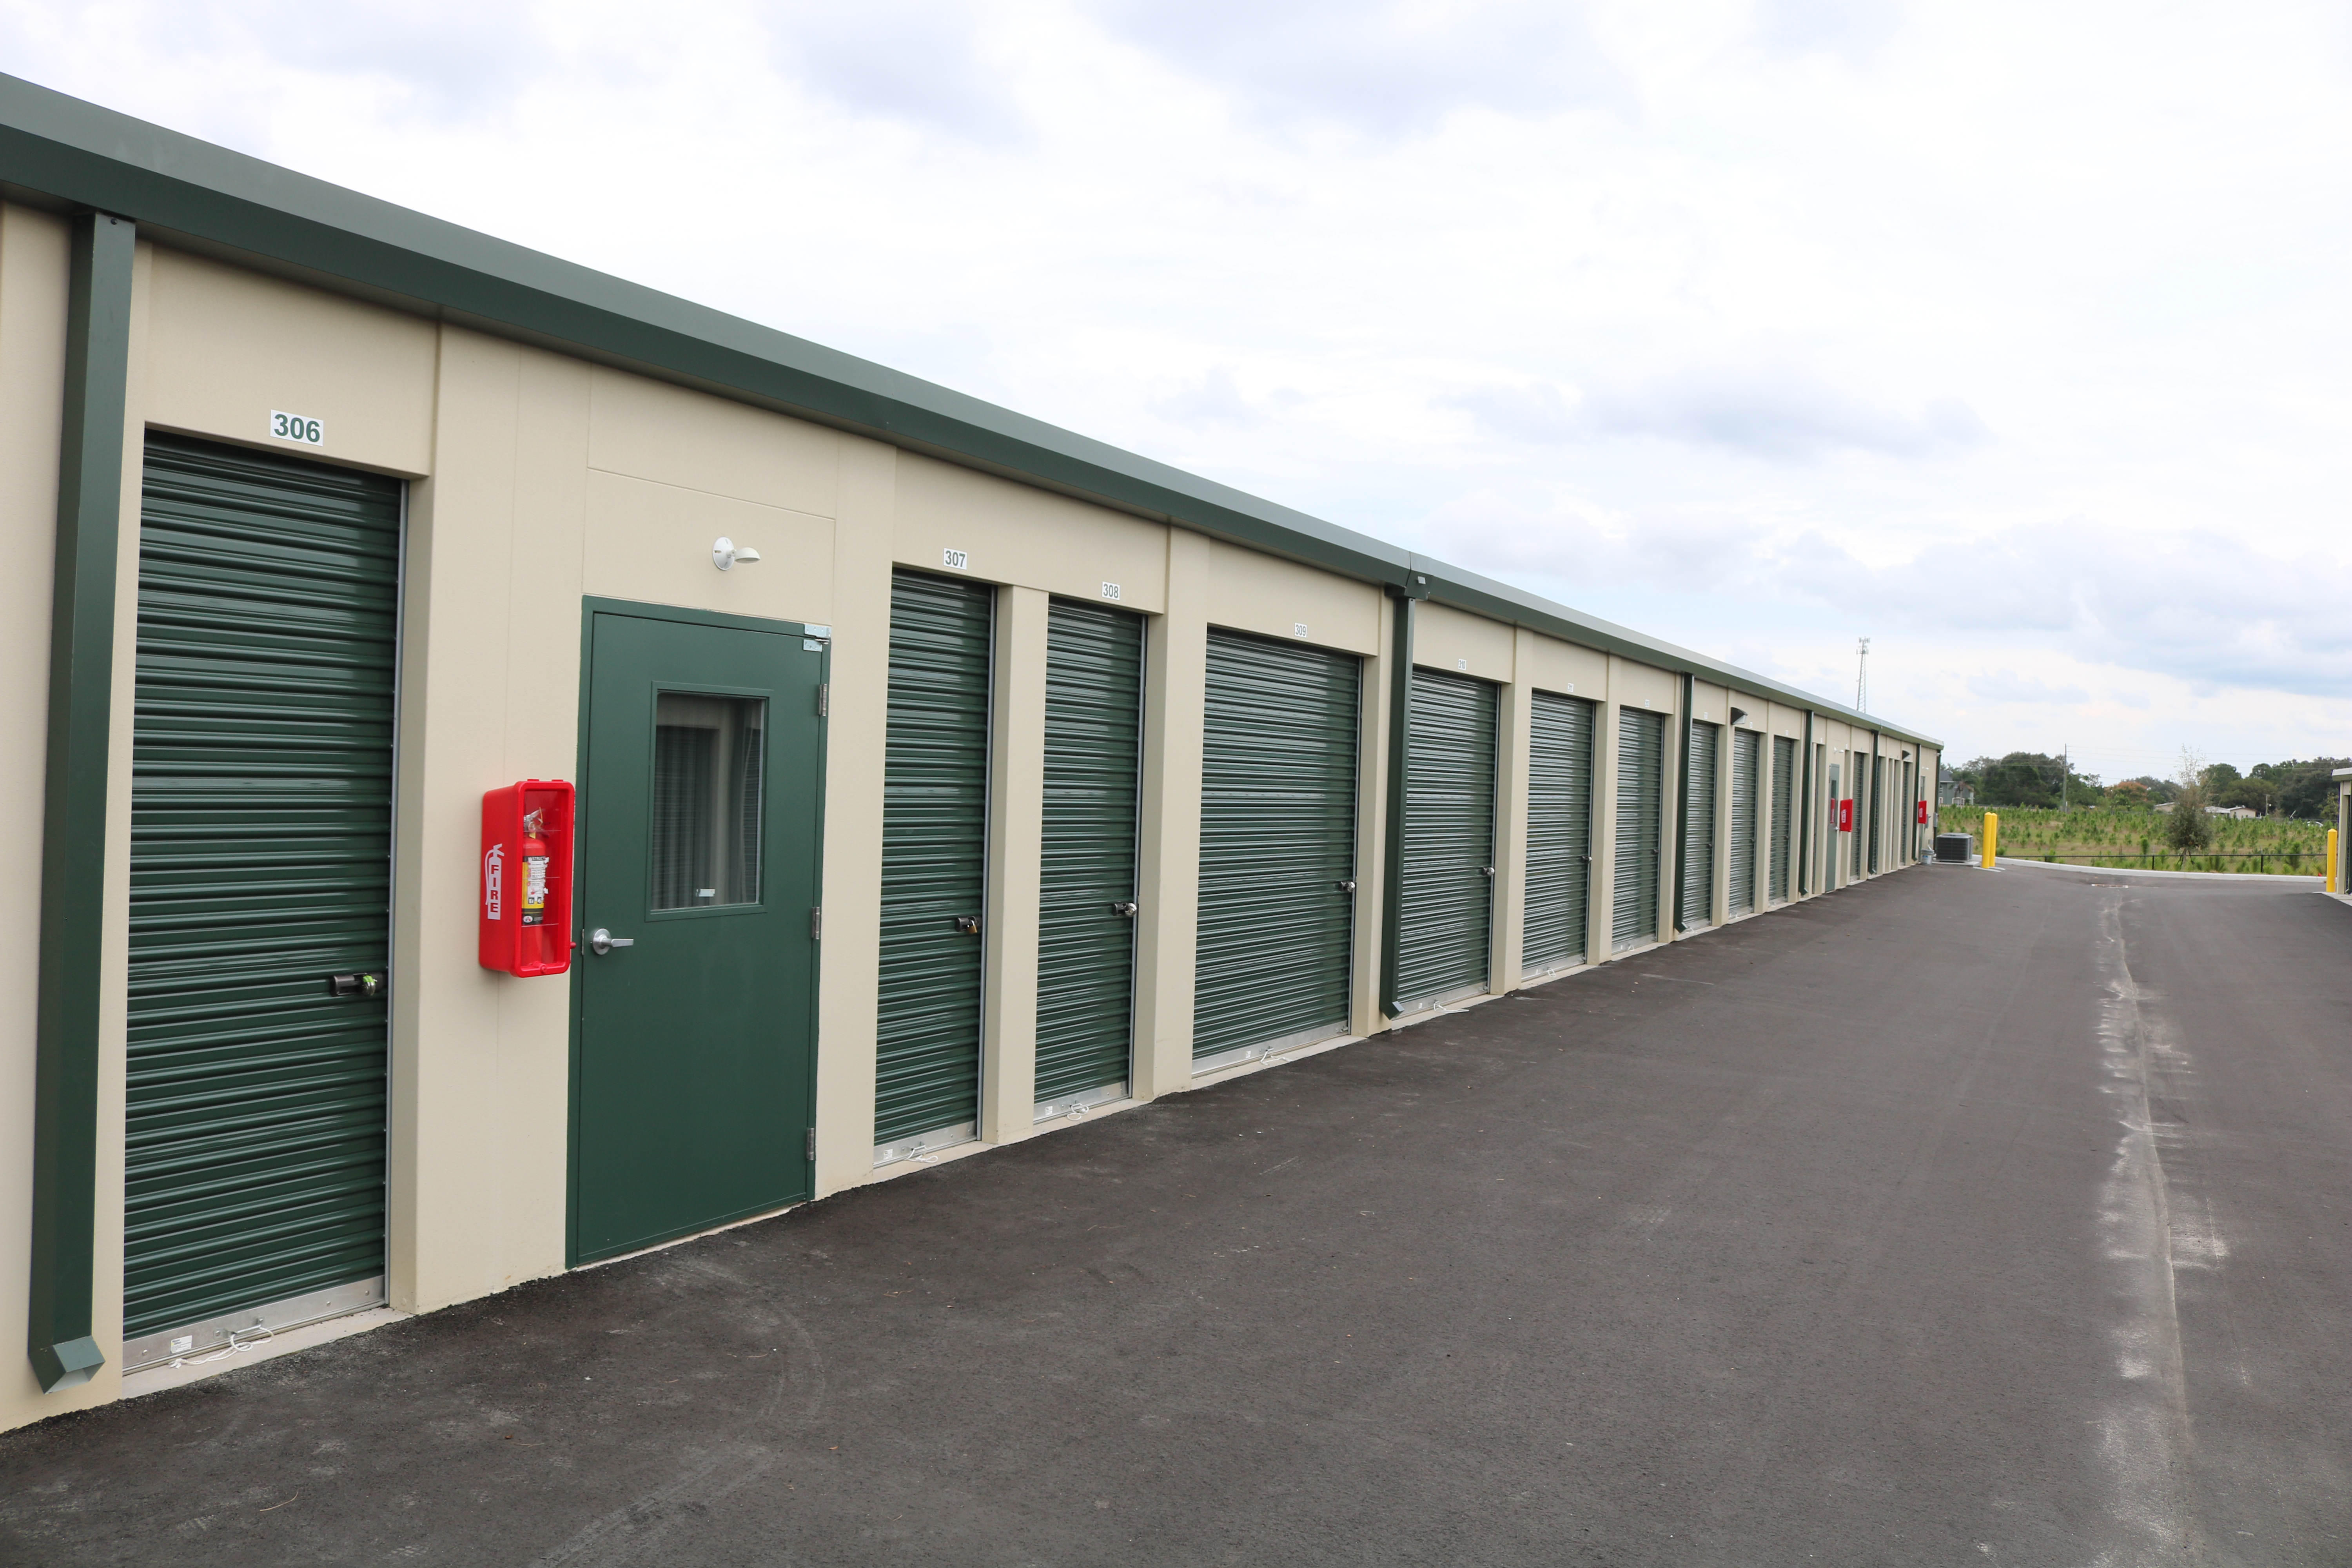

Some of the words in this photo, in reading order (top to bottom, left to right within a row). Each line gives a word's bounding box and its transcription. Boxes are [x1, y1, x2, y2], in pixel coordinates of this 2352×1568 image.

[274, 414, 320, 443] 306
[945, 550, 965, 567] 307
[1103, 583, 1118, 598] 308
[1296, 624, 1306, 636] 309
[490, 864, 499, 913] FIRE
